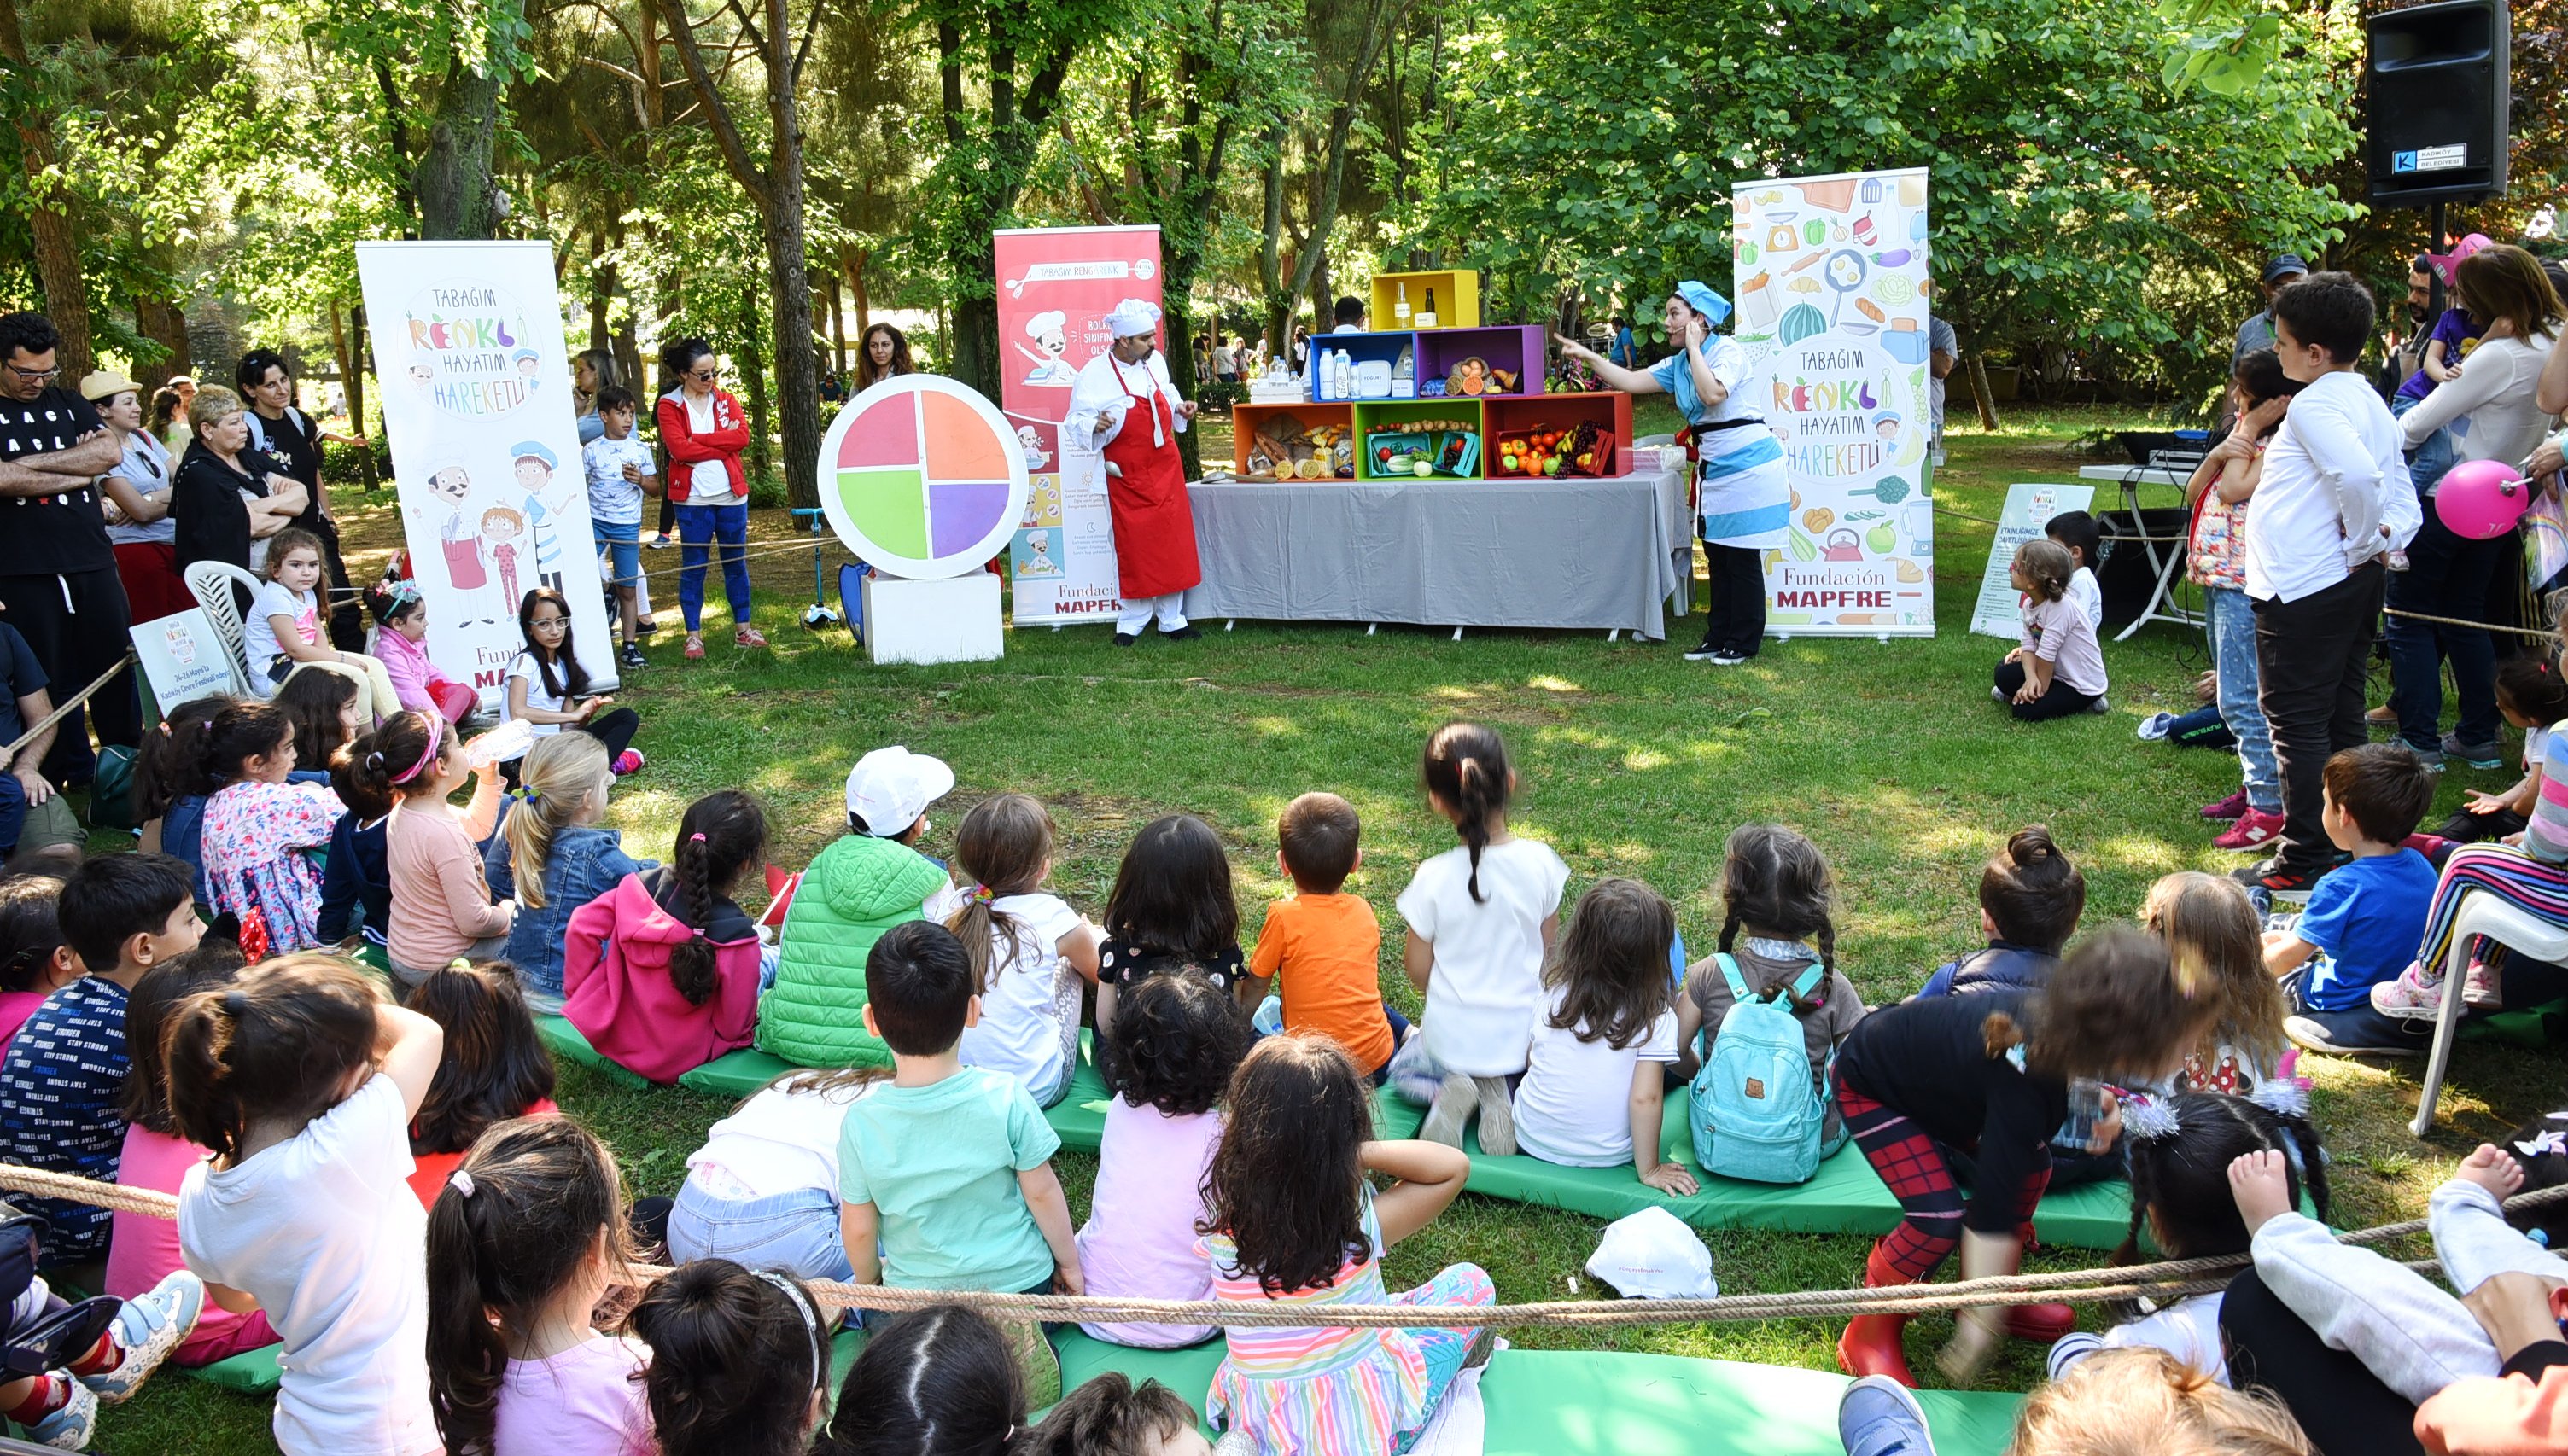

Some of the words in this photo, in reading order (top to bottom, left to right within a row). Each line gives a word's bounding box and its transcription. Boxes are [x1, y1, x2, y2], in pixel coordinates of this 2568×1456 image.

[2421, 149, 2452, 158] KADIKÖY
[2420, 159, 2460, 167] BELEDİYESİ
[431, 287, 497, 308] TABAĞIM
[442, 352, 507, 373] HAYATIM
[1800, 348, 1865, 371] TABAĞIM
[434, 376, 525, 415] HAREKETLİ
[1800, 416, 1865, 437] HAYATIM
[1786, 440, 1880, 477] HAREKETLİ
[1783, 567, 1885, 586] Fundación
[1059, 582, 1117, 598] Fundaci
[1054, 598, 1123, 614] MAPFR
[1777, 591, 1892, 608] MAPFRE
[475, 641, 522, 666] Fund
[67, 1039, 84, 1048] STAY
[83, 1041, 108, 1053] STRONG
[55, 1052, 79, 1063] STRONG
[80, 1063, 107, 1075] STRONG
[46, 1078, 69, 1088] STRONG
[69, 1080, 87, 1089] STAY
[44, 1093, 60, 1103] STAY
